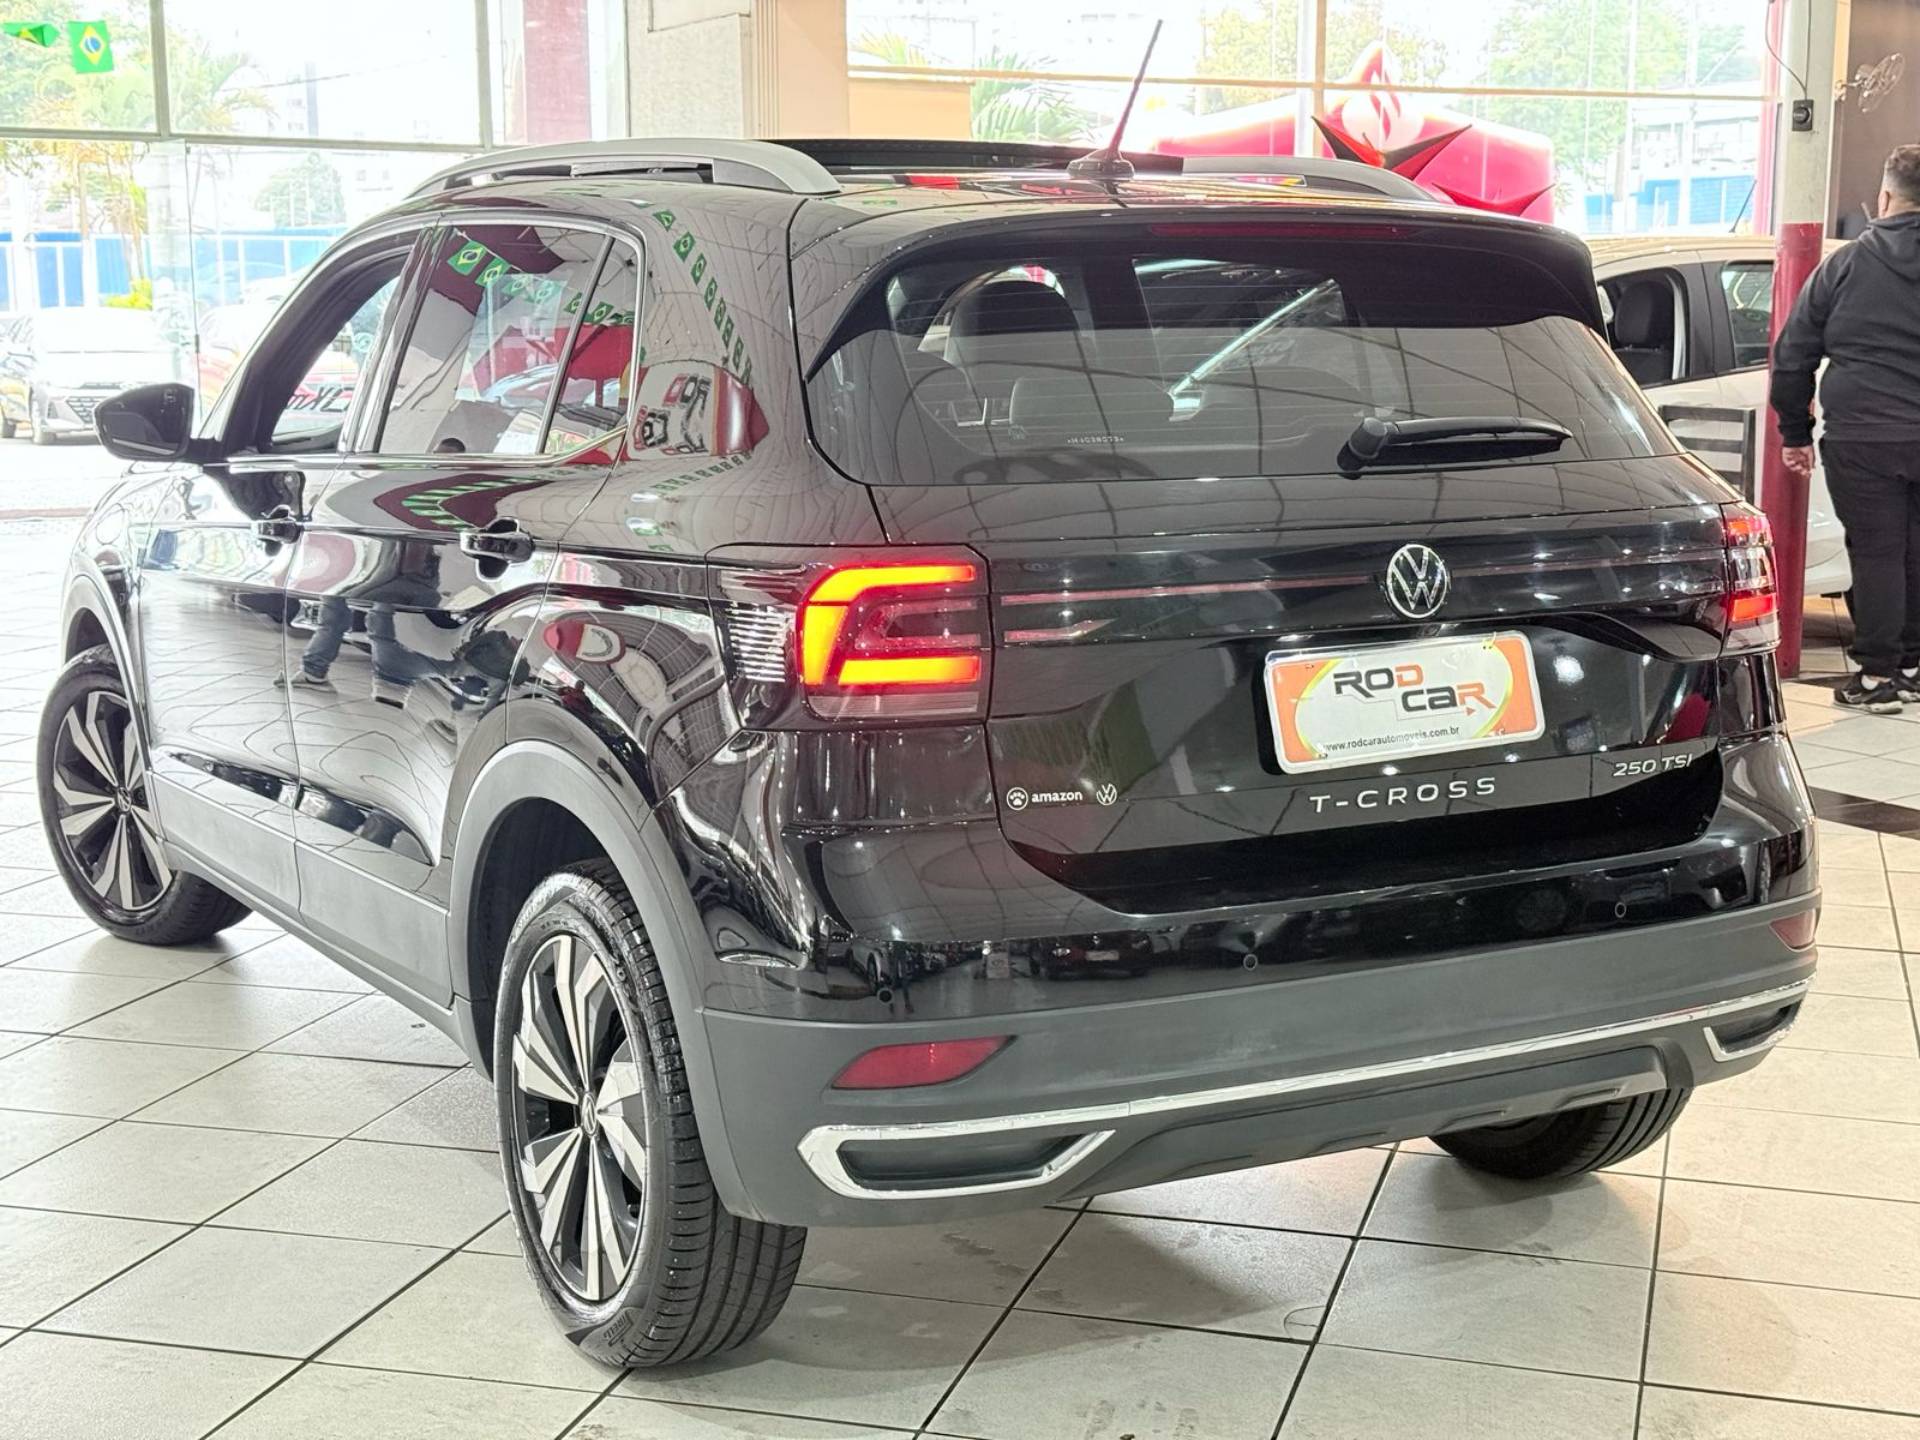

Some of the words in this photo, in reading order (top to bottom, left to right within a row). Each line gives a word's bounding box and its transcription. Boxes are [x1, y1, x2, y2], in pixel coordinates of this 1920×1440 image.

[1333, 664, 1424, 698] ROD
[1322, 726, 1460, 752] www.rodcarautomoveis.com.br
[1613, 759, 1657, 777] 250
[1661, 753, 1693, 771] TSI
[1031, 791, 1083, 803] amazon
[1309, 776, 1496, 814] T-CROSS
